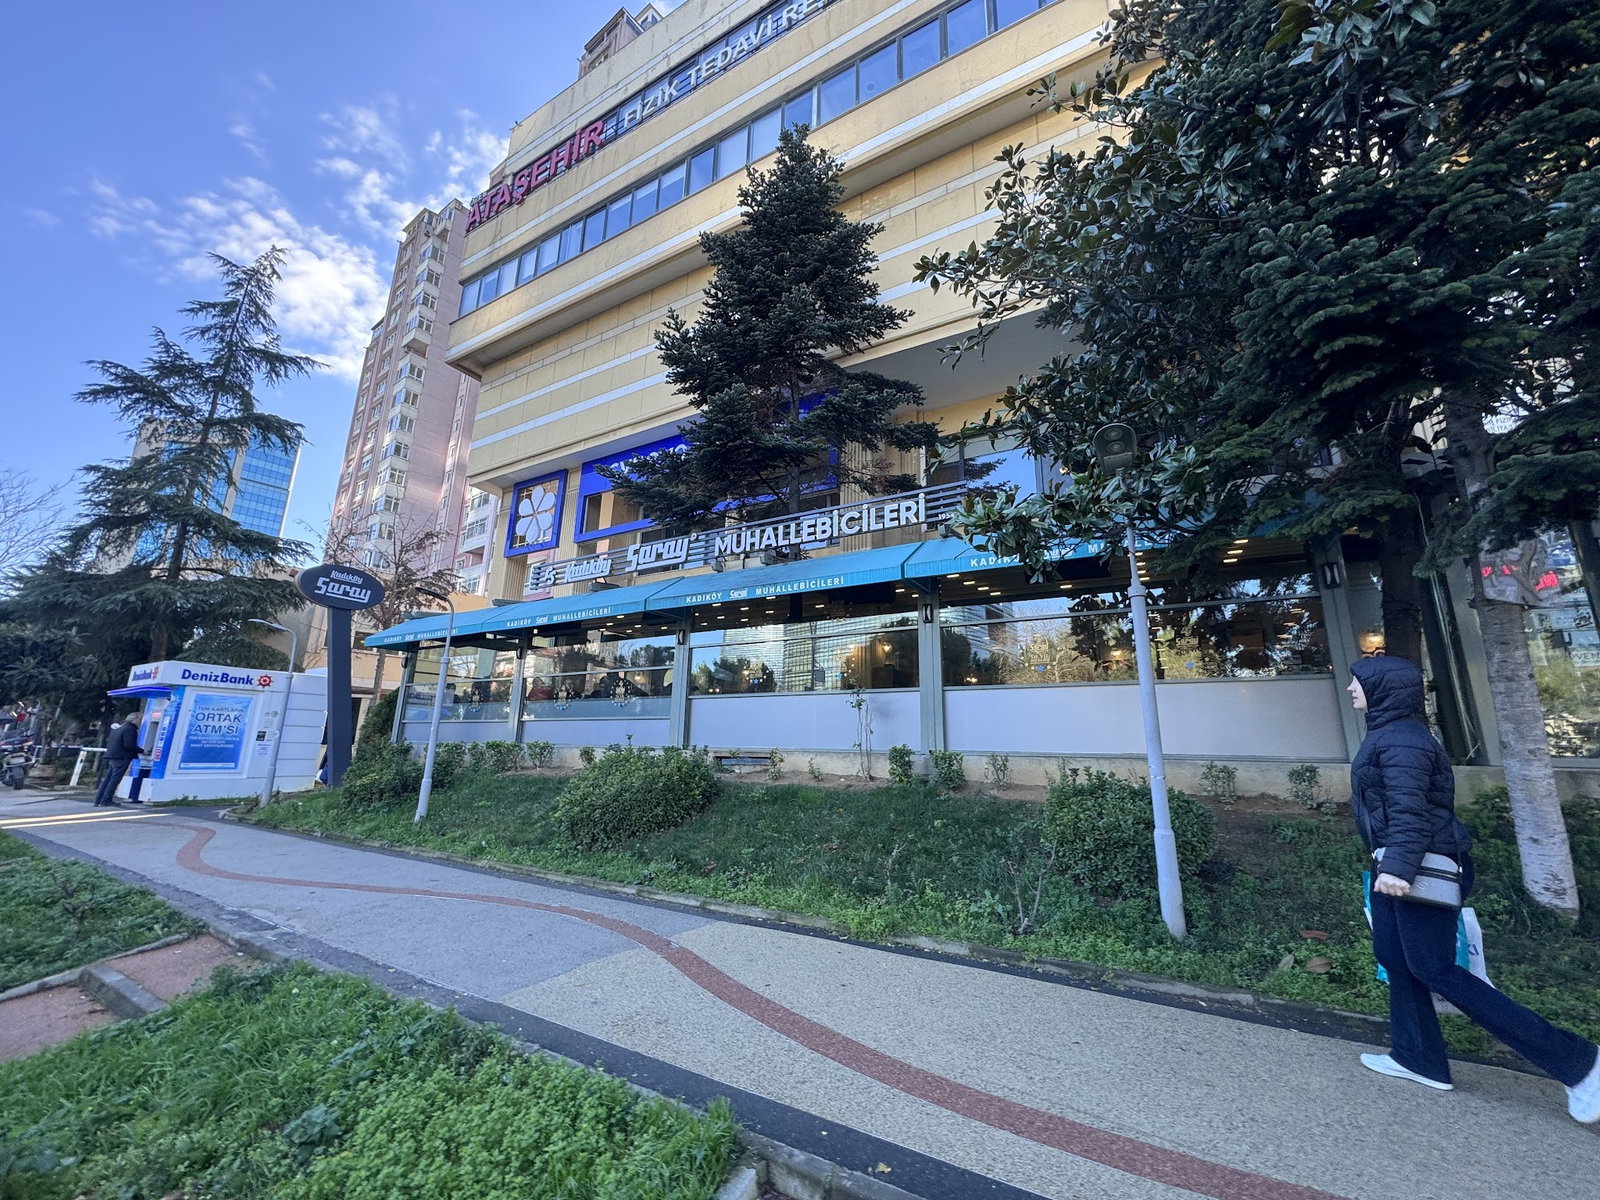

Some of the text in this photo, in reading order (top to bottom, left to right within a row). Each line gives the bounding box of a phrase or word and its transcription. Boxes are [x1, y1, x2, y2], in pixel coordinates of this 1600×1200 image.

[465, 120, 605, 233] ATAŞEHİR
[623, 79, 679, 129] FİZİK
[686, 14, 773, 86] TEDAVİ
[624, 537, 689, 573] Saray
[713, 492, 927, 556] MUHALLEBİCİLERİ
[314, 576, 372, 604] Saray
[686, 592, 722, 604] KADIKÖY
[755, 575, 845, 596] MUHALLEBİCİLERİ
[507, 618, 531, 627] KADIKÖY
[552, 606, 611, 621] MUHALLEBİCİLERİ
[181, 668, 254, 686] DenizBank
[195, 712, 243, 723] ORTAK
